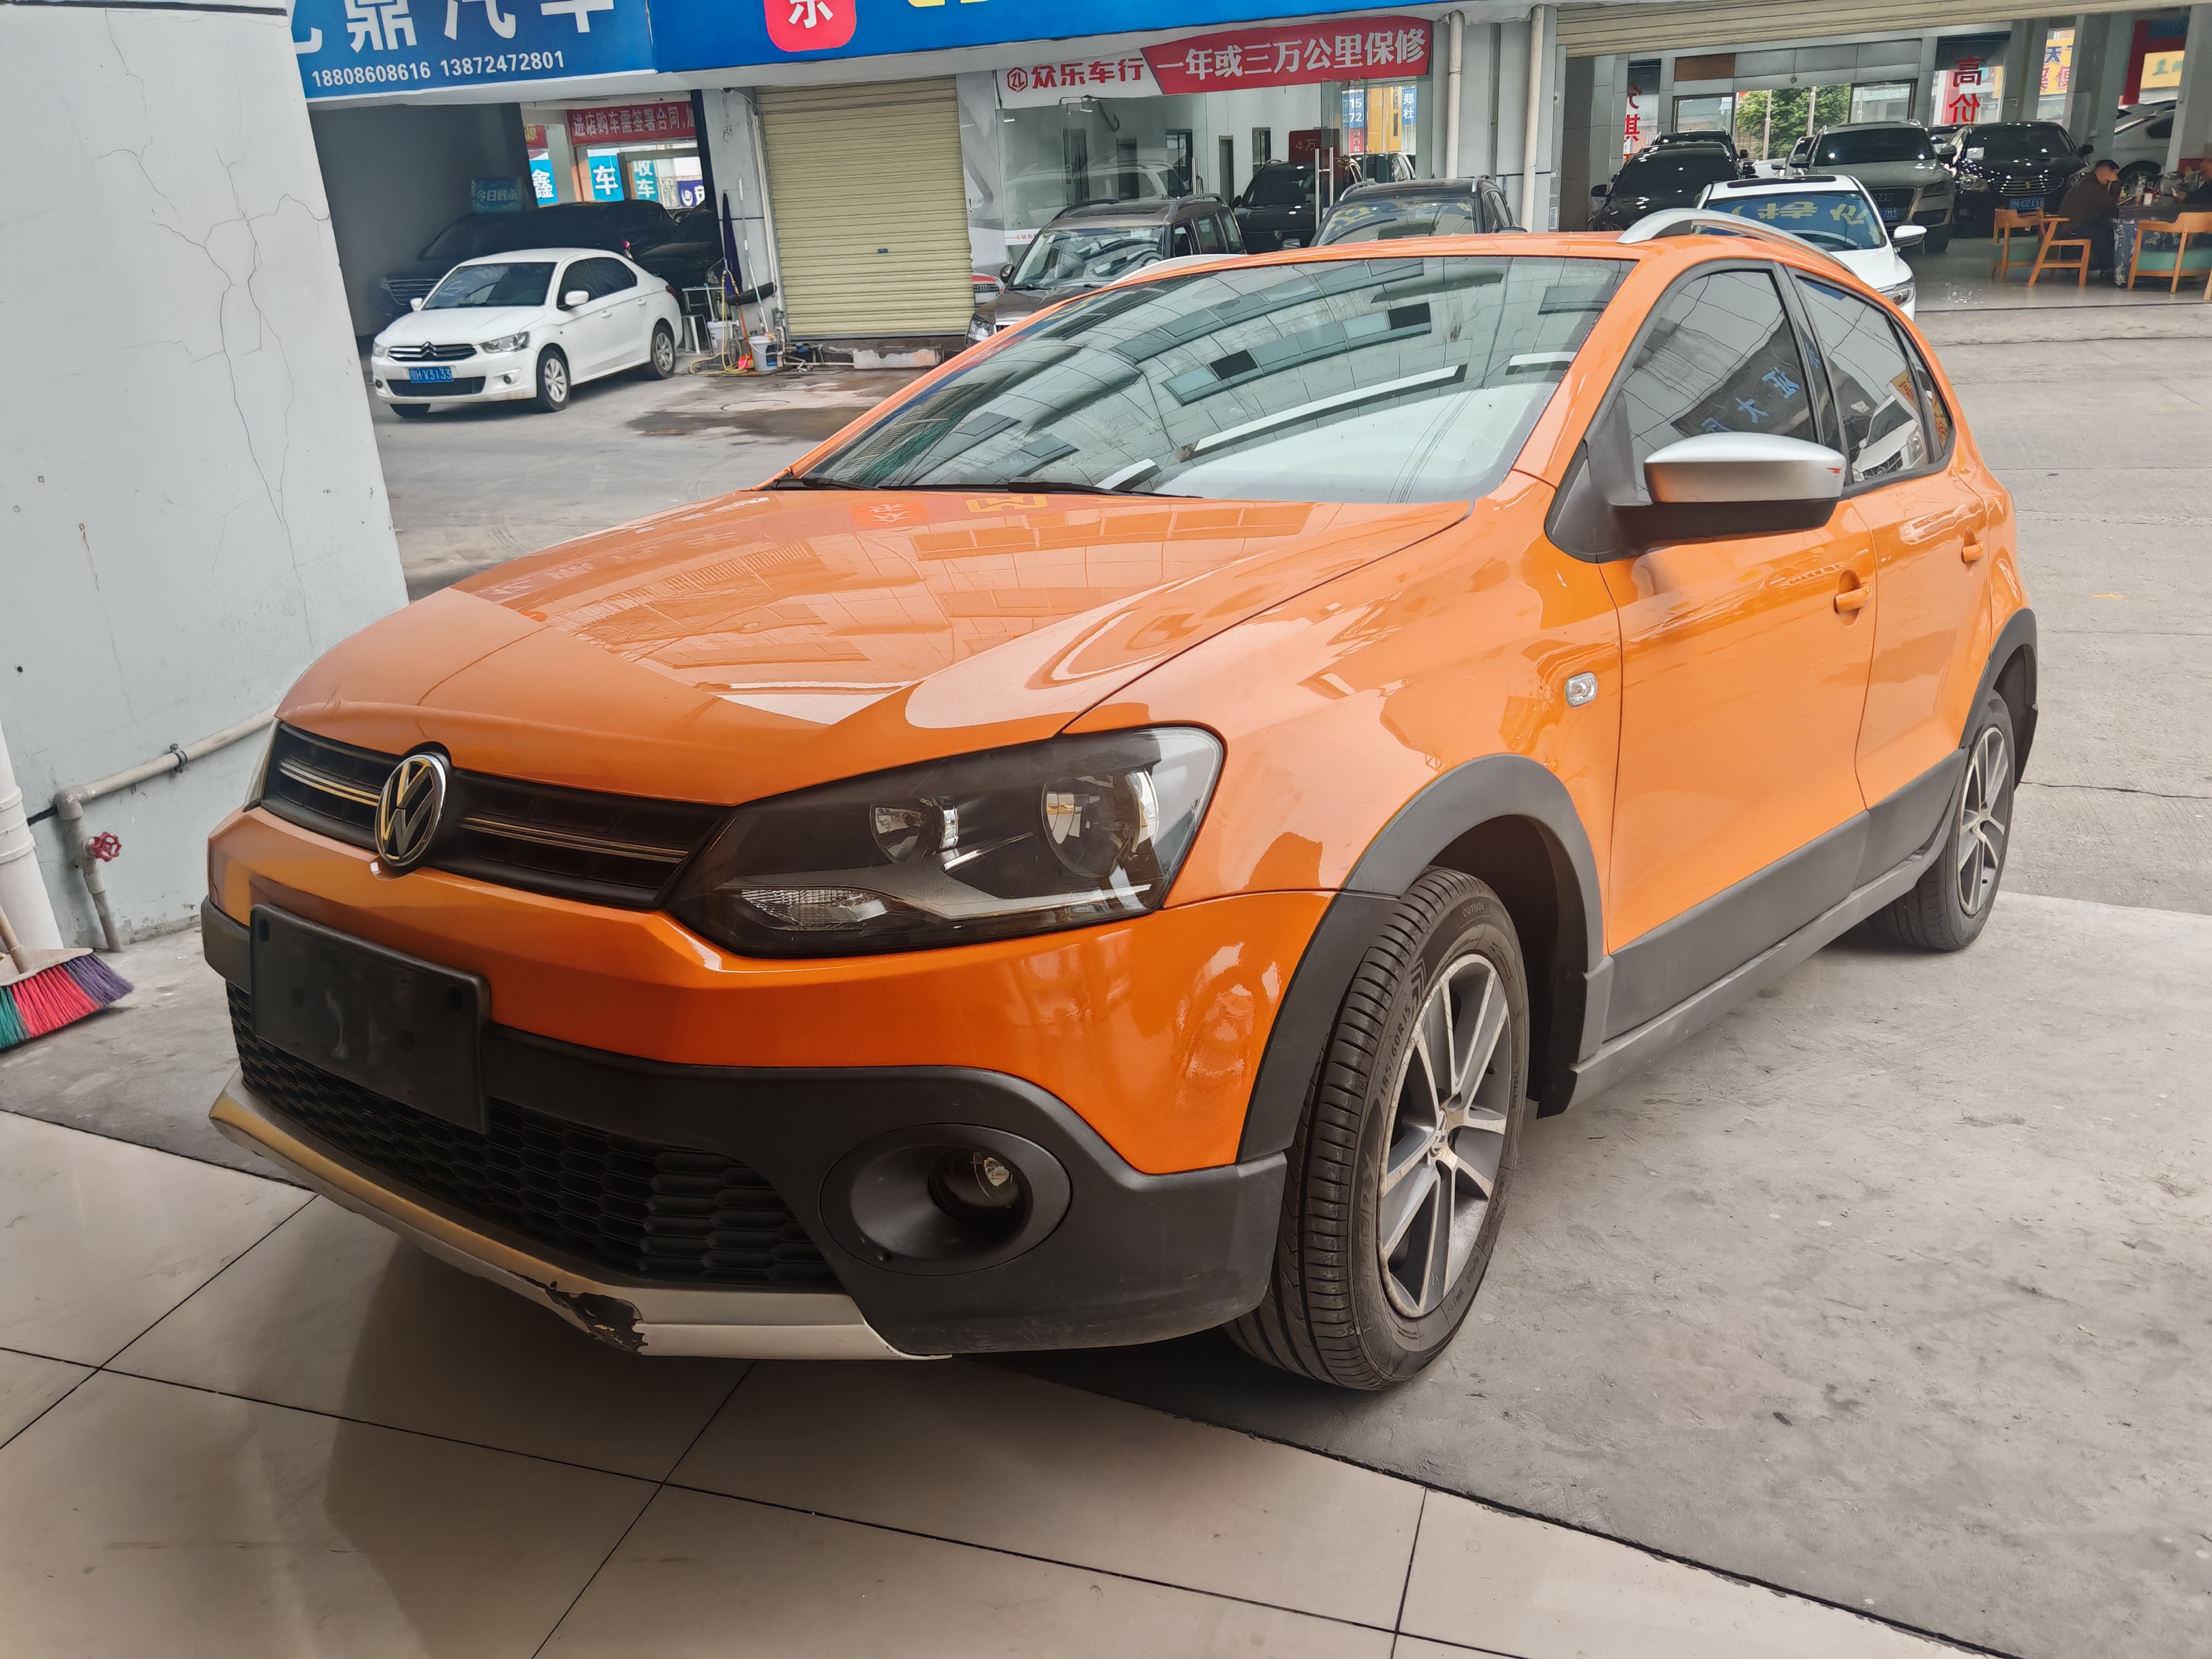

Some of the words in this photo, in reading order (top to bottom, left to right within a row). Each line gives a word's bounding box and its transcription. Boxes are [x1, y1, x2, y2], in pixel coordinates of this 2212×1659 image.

[312, 61, 431, 88] 18808608616
[440, 50, 565, 77] 13872472801
[1156, 28, 1427, 80] 一年或三万公里保修
[1030, 57, 1144, 89] 众乐车行
[1403, 107, 1414, 119] 杜
[593, 165, 619, 195] 车
[1380, 1003, 1411, 1096] 185/60R15
